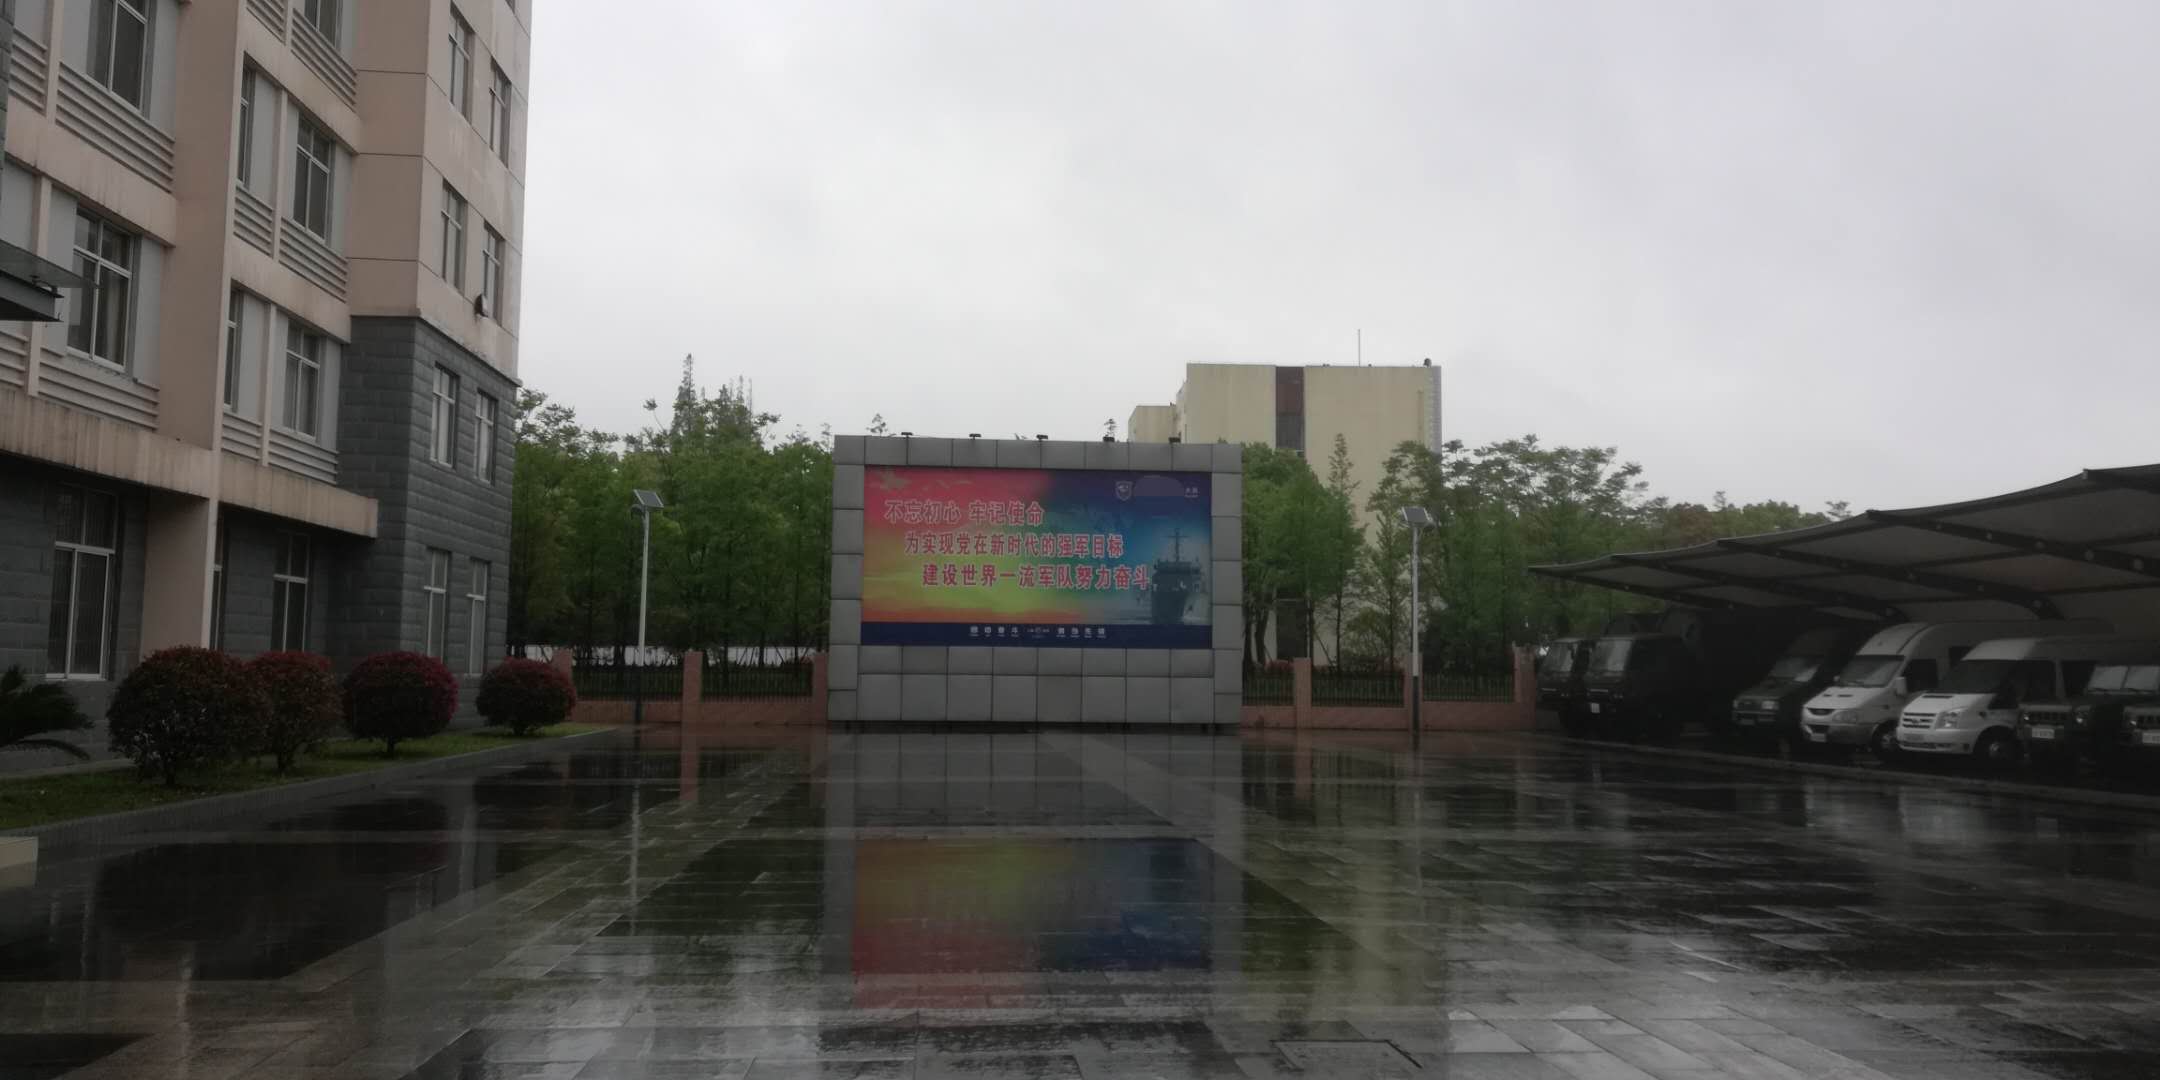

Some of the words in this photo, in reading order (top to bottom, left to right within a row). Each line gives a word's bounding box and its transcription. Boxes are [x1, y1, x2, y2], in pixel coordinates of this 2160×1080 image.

[885, 500, 961, 525] 不忘初心
[968, 500, 1045, 526] 牢记使命
[904, 532, 1124, 558] 为实现党在新时代的强军目标
[922, 563, 1151, 590] 建设世界一流军队努力奋斗
